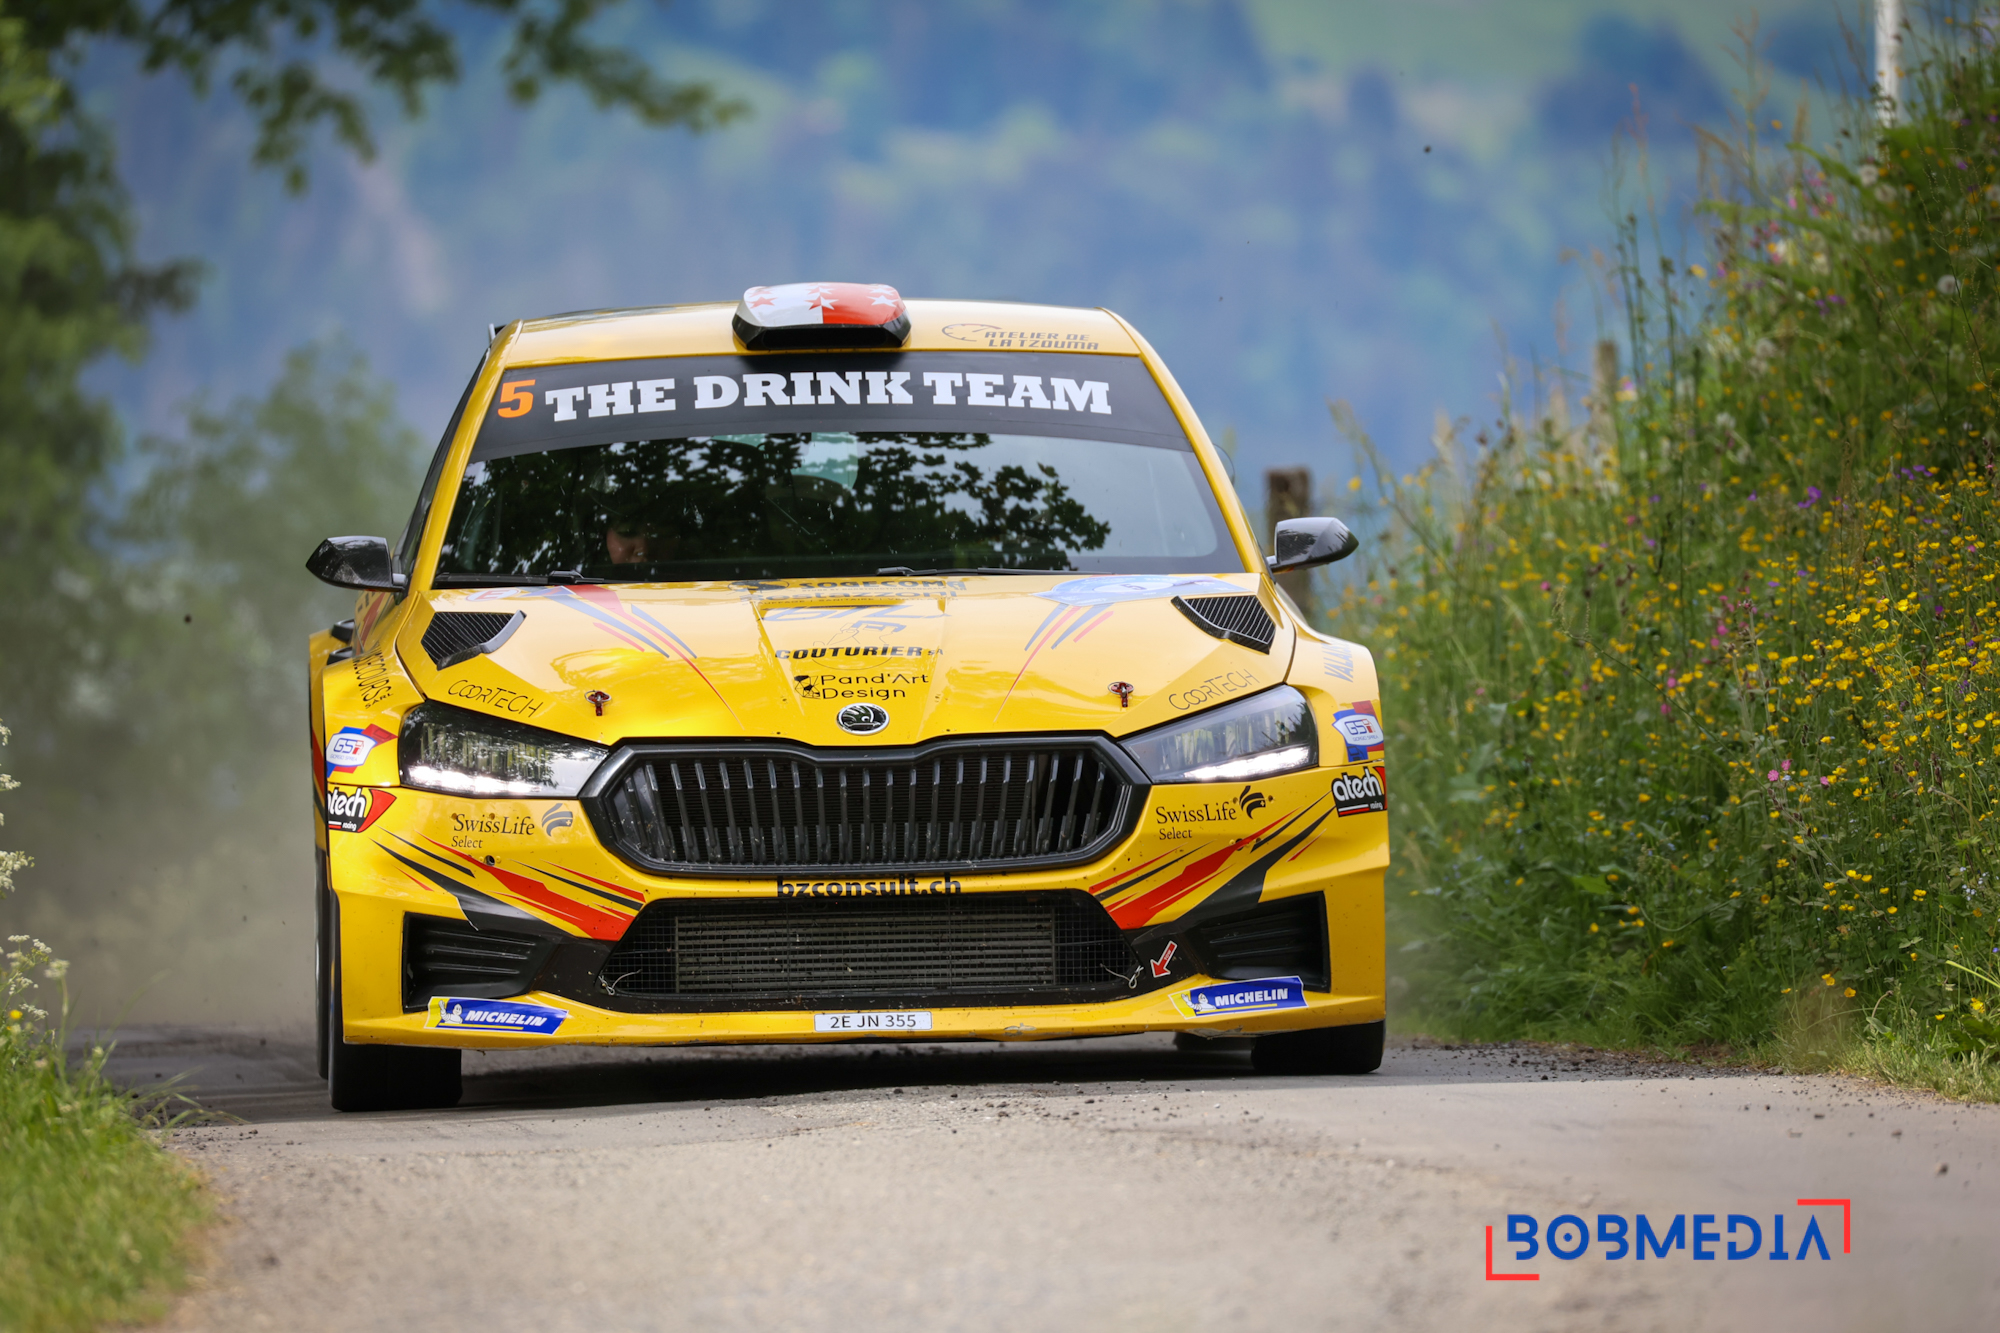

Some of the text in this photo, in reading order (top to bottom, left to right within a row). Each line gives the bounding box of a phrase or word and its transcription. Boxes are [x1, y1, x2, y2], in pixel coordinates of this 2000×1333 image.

[984, 331, 1090, 341] ATELIER DE
[988, 339, 1099, 350] LA TZOUMA
[497, 379, 536, 418] 5
[545, 371, 1112, 422] THE DRINK TEAM
[775, 646, 923, 660] COUTURIER
[820, 673, 929, 685] Pand'Art
[822, 687, 906, 701] Design
[1333, 768, 1382, 802] atech
[1158, 828, 1193, 841] Select
[451, 835, 483, 849] Select
[777, 875, 962, 897] bzconsult.ch
[1214, 988, 1289, 1007] MICHELIN
[464, 1010, 548, 1027] MICHELIN
[830, 1014, 917, 1029] 2E JN 355
